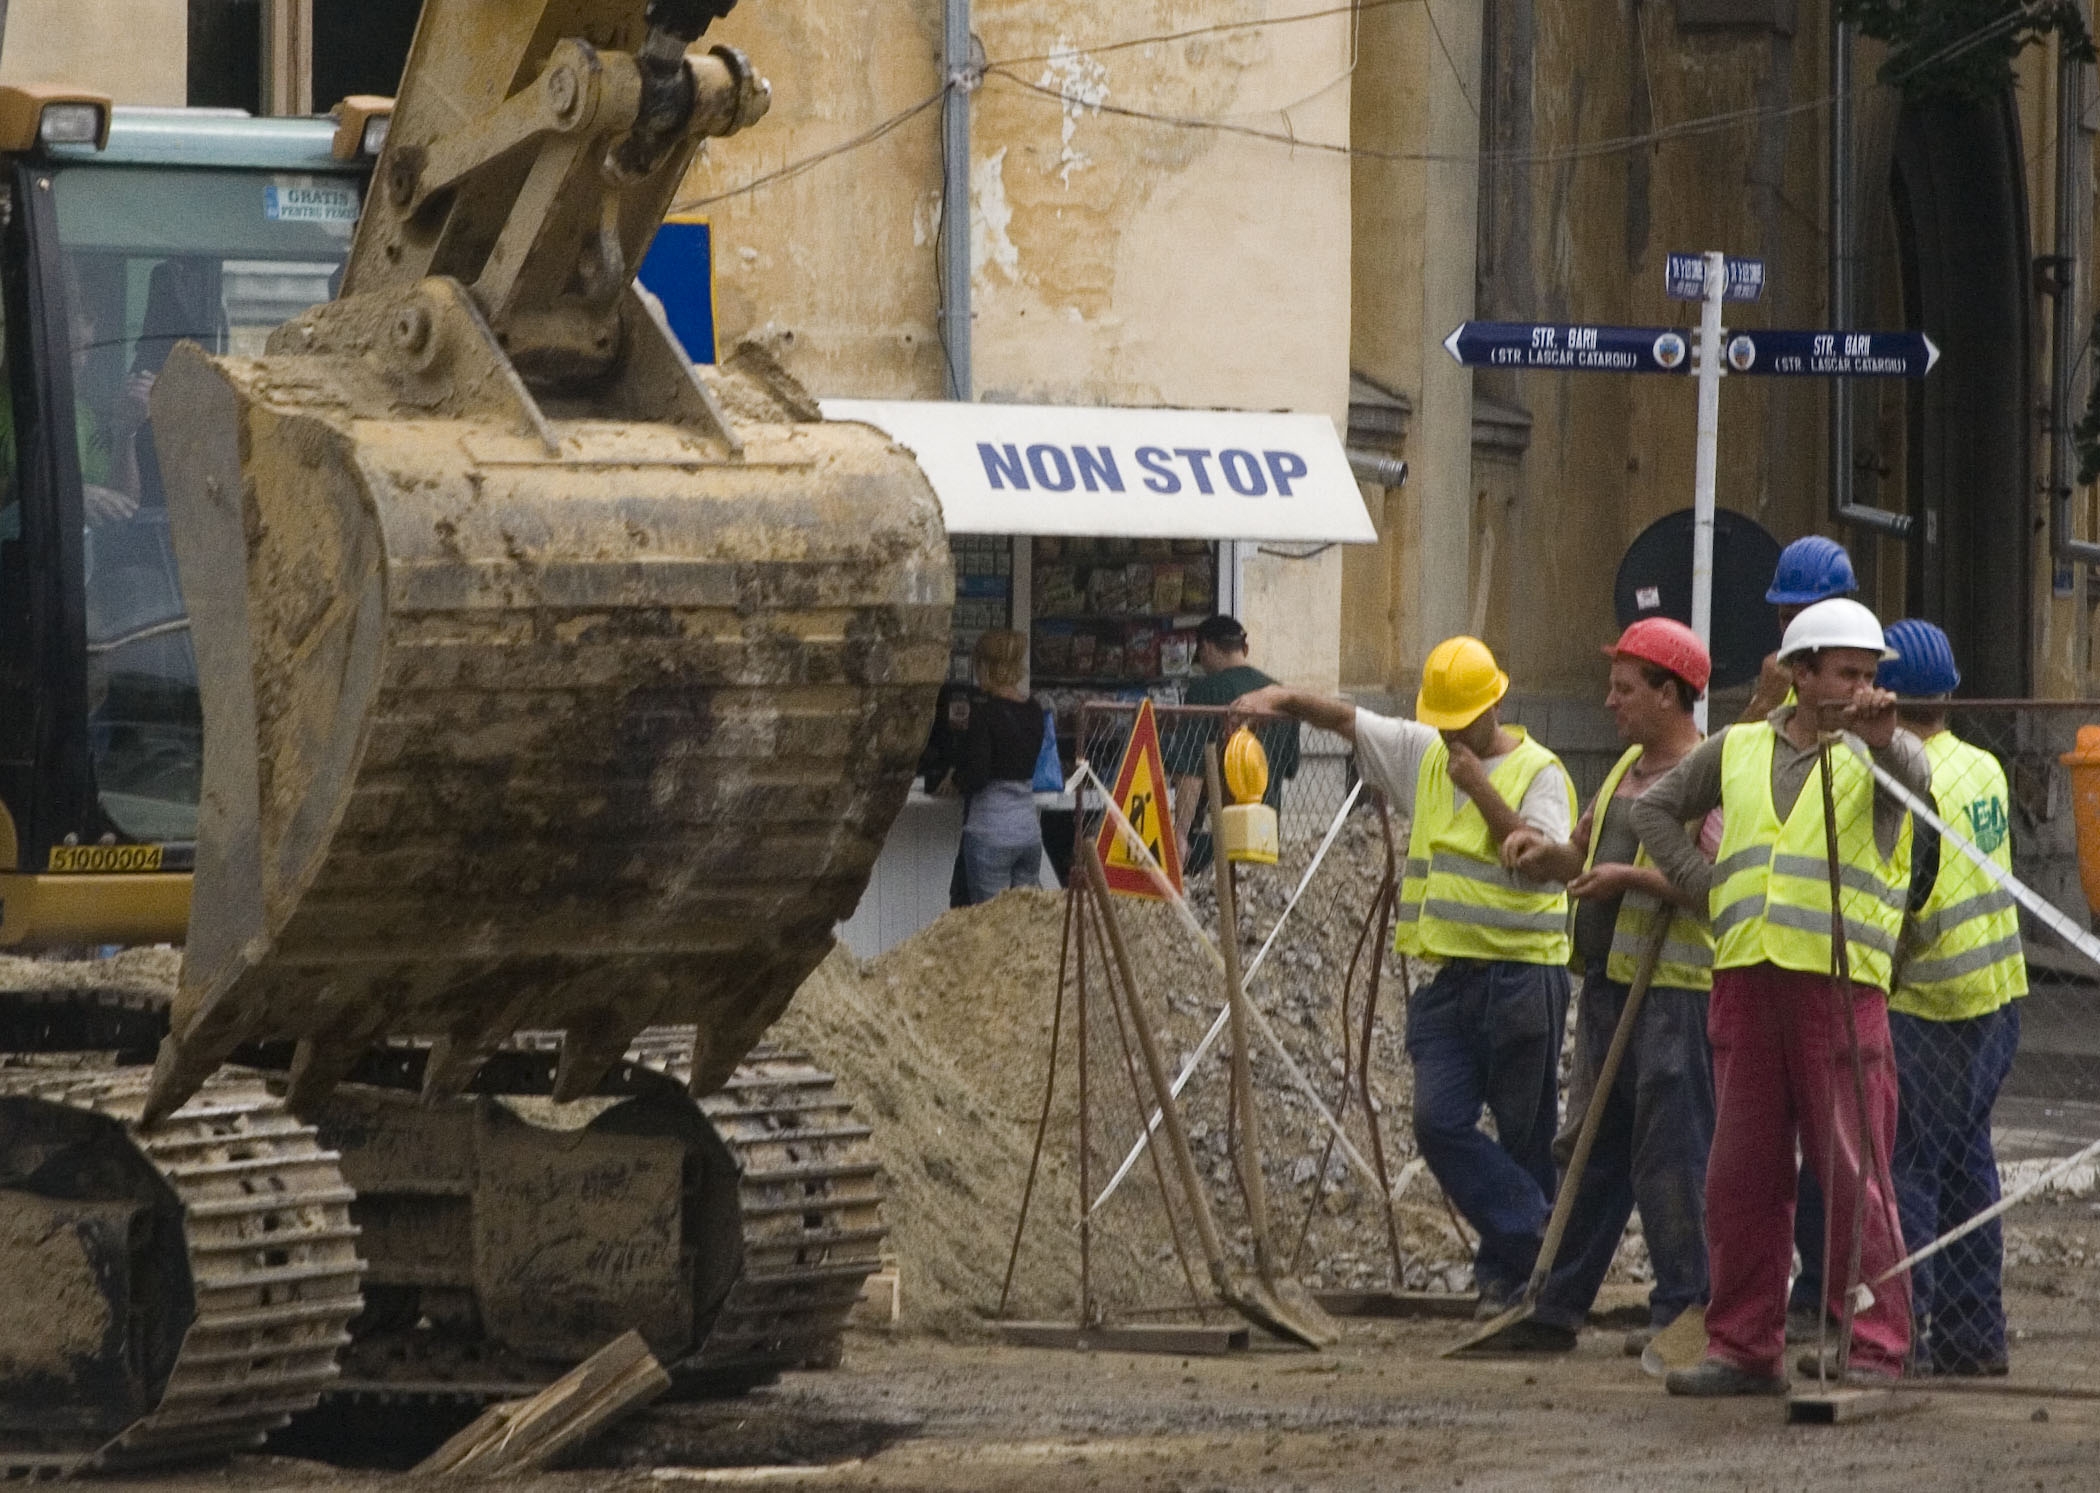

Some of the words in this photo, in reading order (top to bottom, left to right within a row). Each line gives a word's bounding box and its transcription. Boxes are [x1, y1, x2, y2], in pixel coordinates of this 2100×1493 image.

[1531, 327, 1558, 349] STR.
[976, 442, 1126, 492] NON
[1134, 446, 1308, 497] STOP
